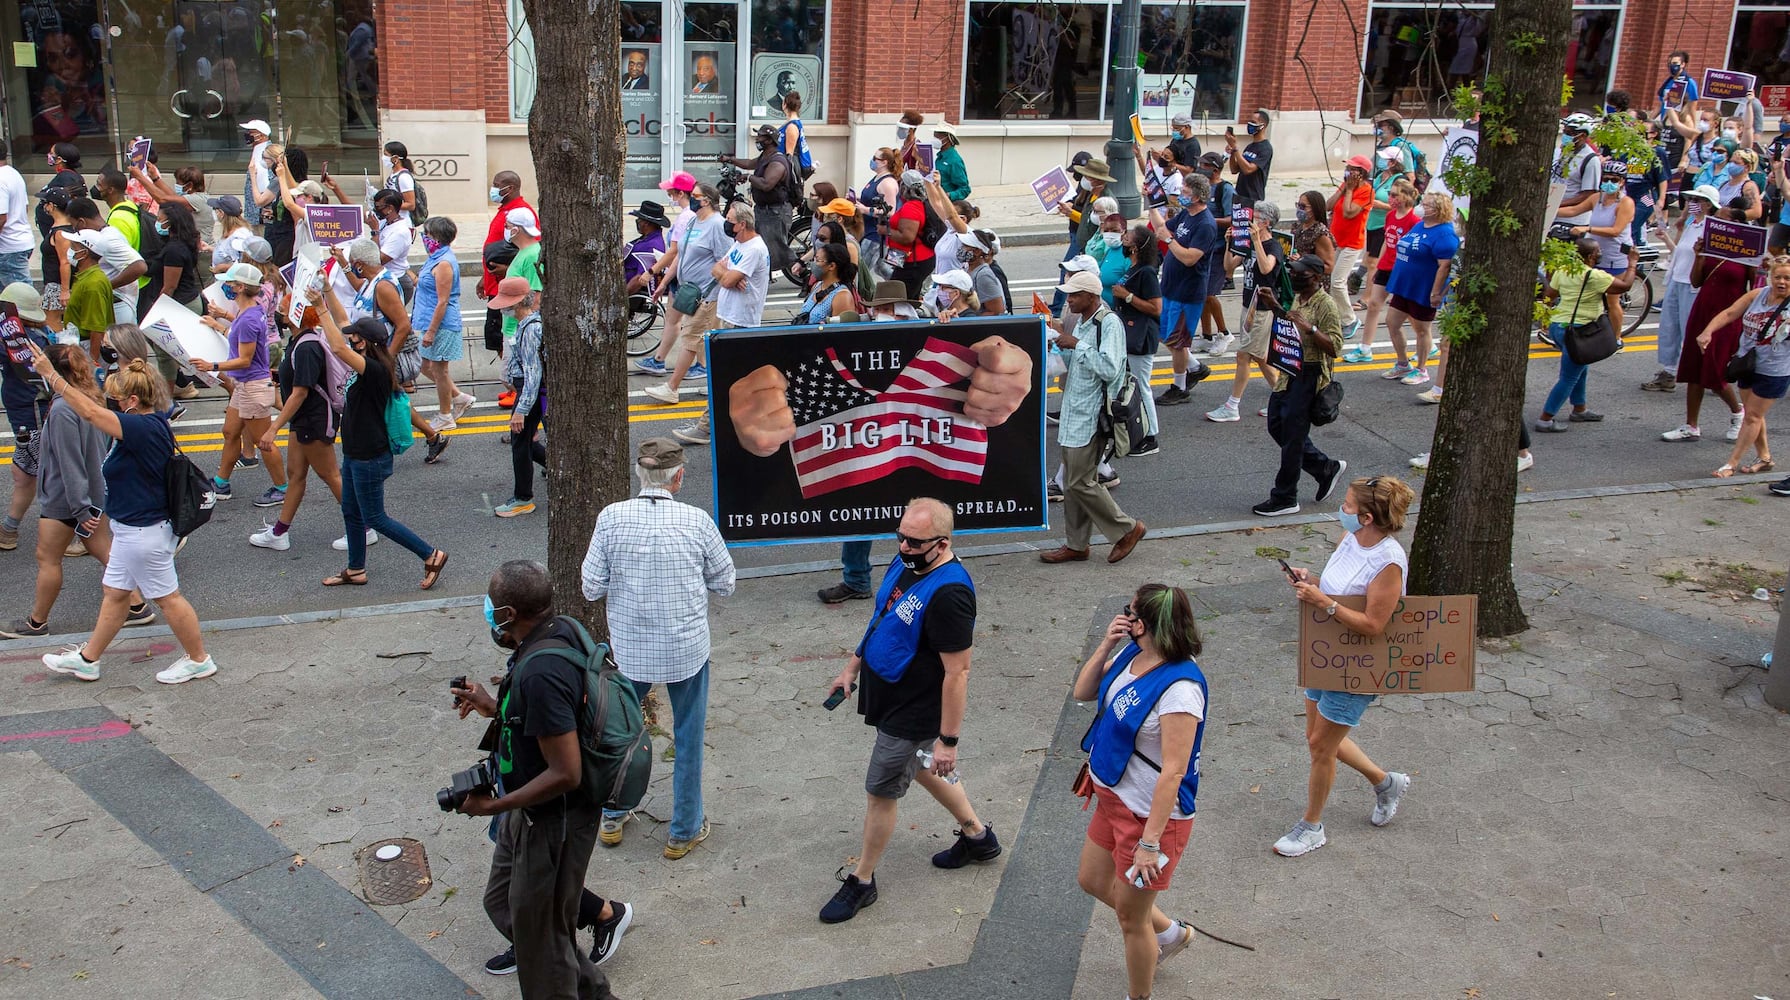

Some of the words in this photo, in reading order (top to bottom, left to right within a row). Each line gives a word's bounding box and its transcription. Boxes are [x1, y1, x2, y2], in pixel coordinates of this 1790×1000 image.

[773, 62, 801, 71] CHRISTIAN
[413, 159, 458, 177] 320
[310, 209, 323, 217] PASS
[315, 230, 337, 238] PEOPLE
[338, 230, 355, 238] ACT
[1710, 222, 1727, 231] PASS
[1711, 233, 1727, 243] FOR
[1728, 236, 1744, 246] THE
[1710, 241, 1739, 252] PEOPLE
[1740, 248, 1757, 256] ACT
[1275, 344, 1300, 357] VOTING
[1289, 339, 1300, 348] OUR
[851, 350, 901, 371] THE
[820, 421, 880, 450] BIG
[899, 417, 954, 446] LIE
[728, 513, 754, 528] ITS
[761, 510, 822, 526] POISON
[829, 505, 907, 522] CONTINU
[956, 499, 1034, 515] SPREAD...
[1391, 599, 1460, 630] People
[1384, 625, 1424, 645] want
[1310, 639, 1375, 669] Some
[1388, 642, 1457, 671] People
[1339, 668, 1361, 690] to
[1369, 671, 1423, 690] VOTE
